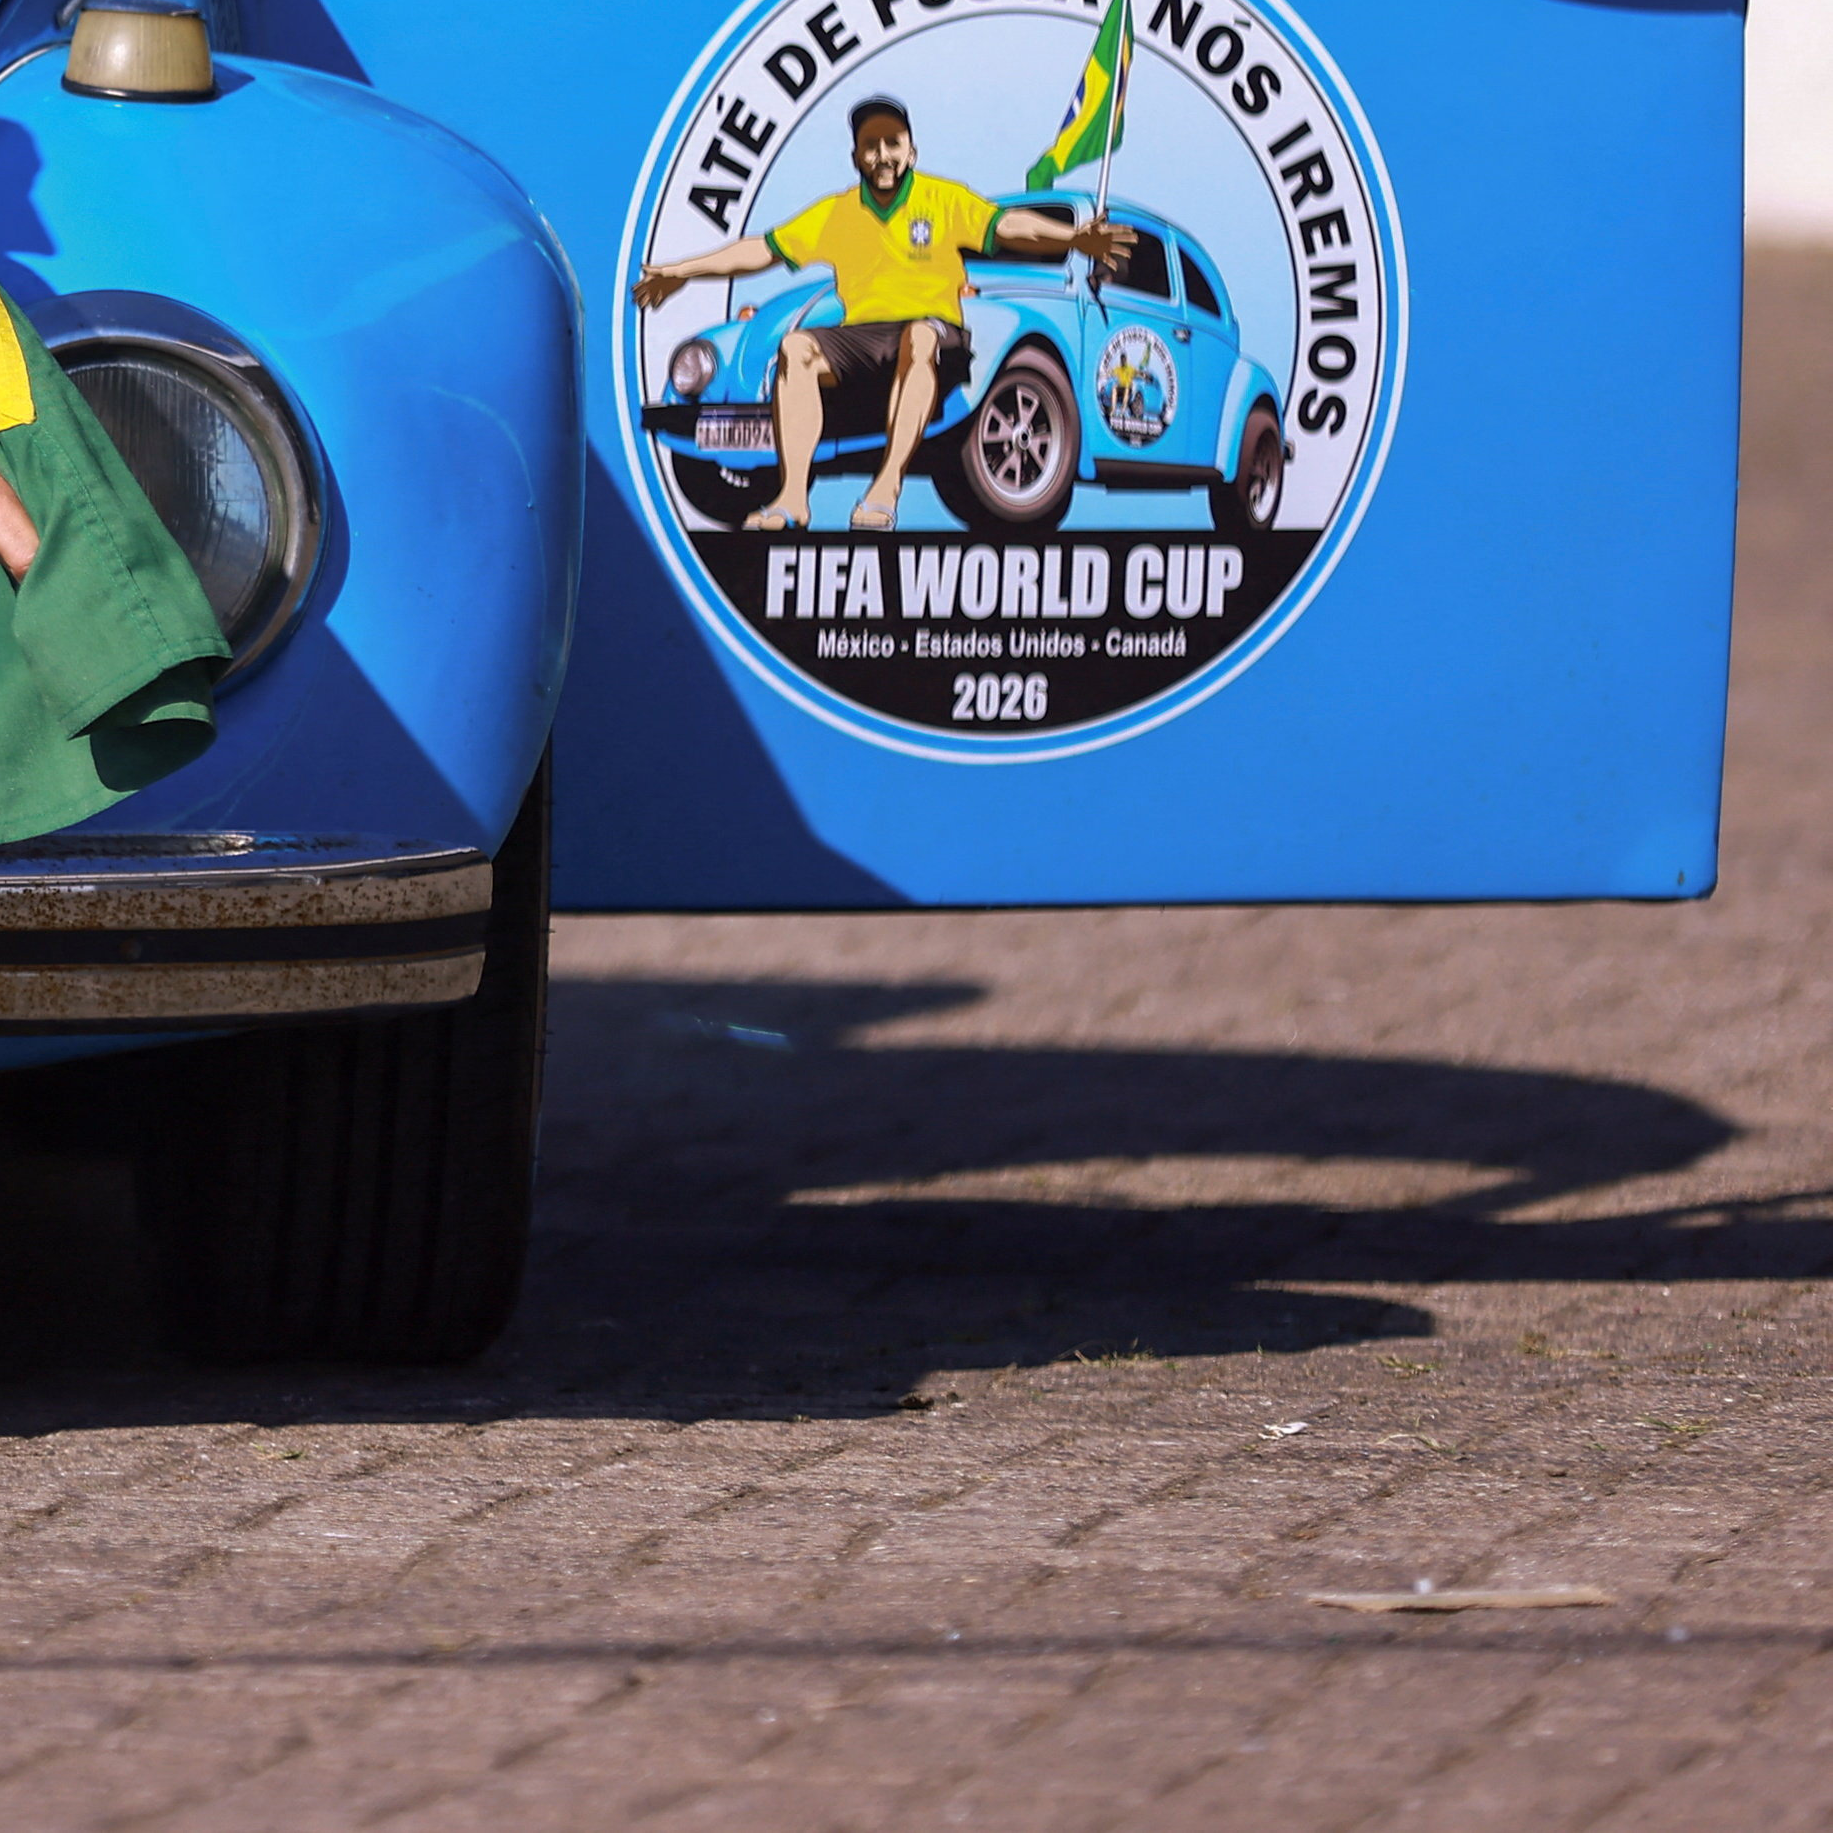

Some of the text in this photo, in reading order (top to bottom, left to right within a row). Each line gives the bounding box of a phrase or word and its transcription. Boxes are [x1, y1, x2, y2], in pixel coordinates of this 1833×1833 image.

[689, 96, 775, 234] ATÉ
[764, 1, 861, 103] DE
[1269, 119, 1357, 436] IREMOS
[765, 543, 1243, 620] FIFA WORLD CUP
[817, 627, 895, 659] México
[914, 628, 1003, 659] Estados
[1008, 628, 1085, 658] Unidos
[1105, 626, 1186, 658] Canadá
[952, 671, 1049, 721] 2026
